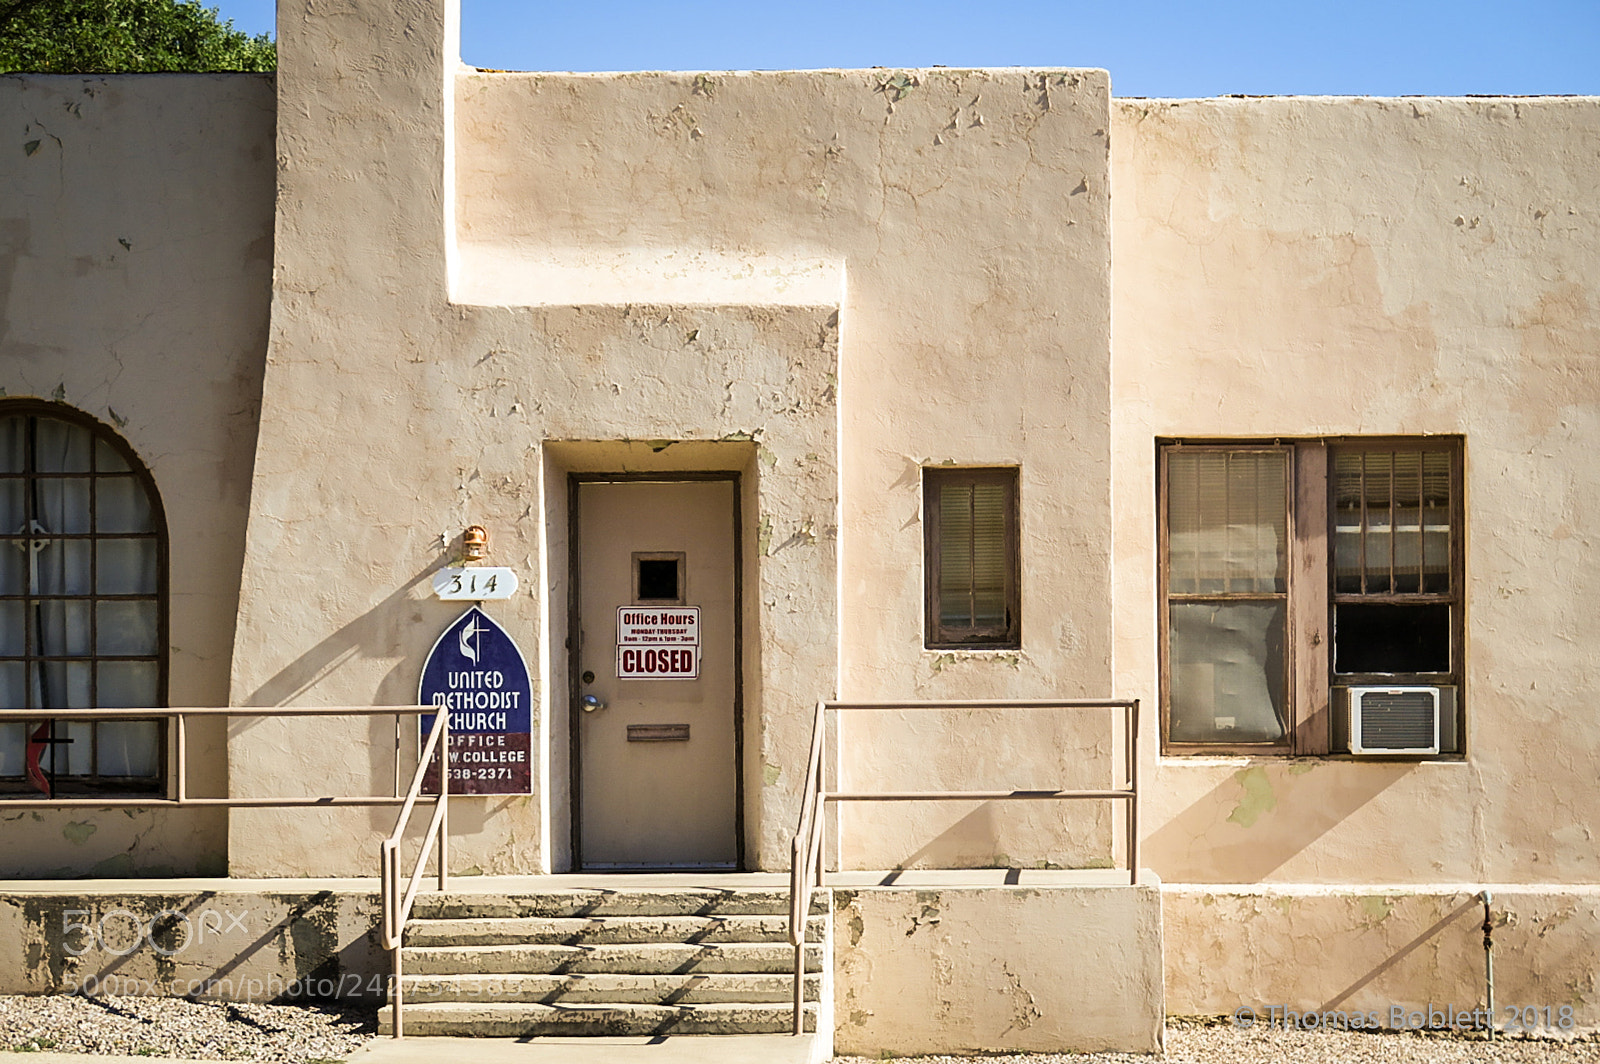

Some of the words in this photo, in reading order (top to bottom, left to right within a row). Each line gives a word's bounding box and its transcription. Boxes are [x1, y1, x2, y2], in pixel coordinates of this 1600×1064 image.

[448, 574, 498, 595] 314
[623, 613, 658, 625] Office
[660, 613, 695, 625] Hours
[622, 649, 693, 674] CLOSED
[448, 671, 504, 689] UNITED
[432, 691, 520, 709] METHODIST
[446, 712, 507, 730] CHURCH
[447, 735, 506, 747] OFFICE
[462, 751, 525, 763] COLLEGE
